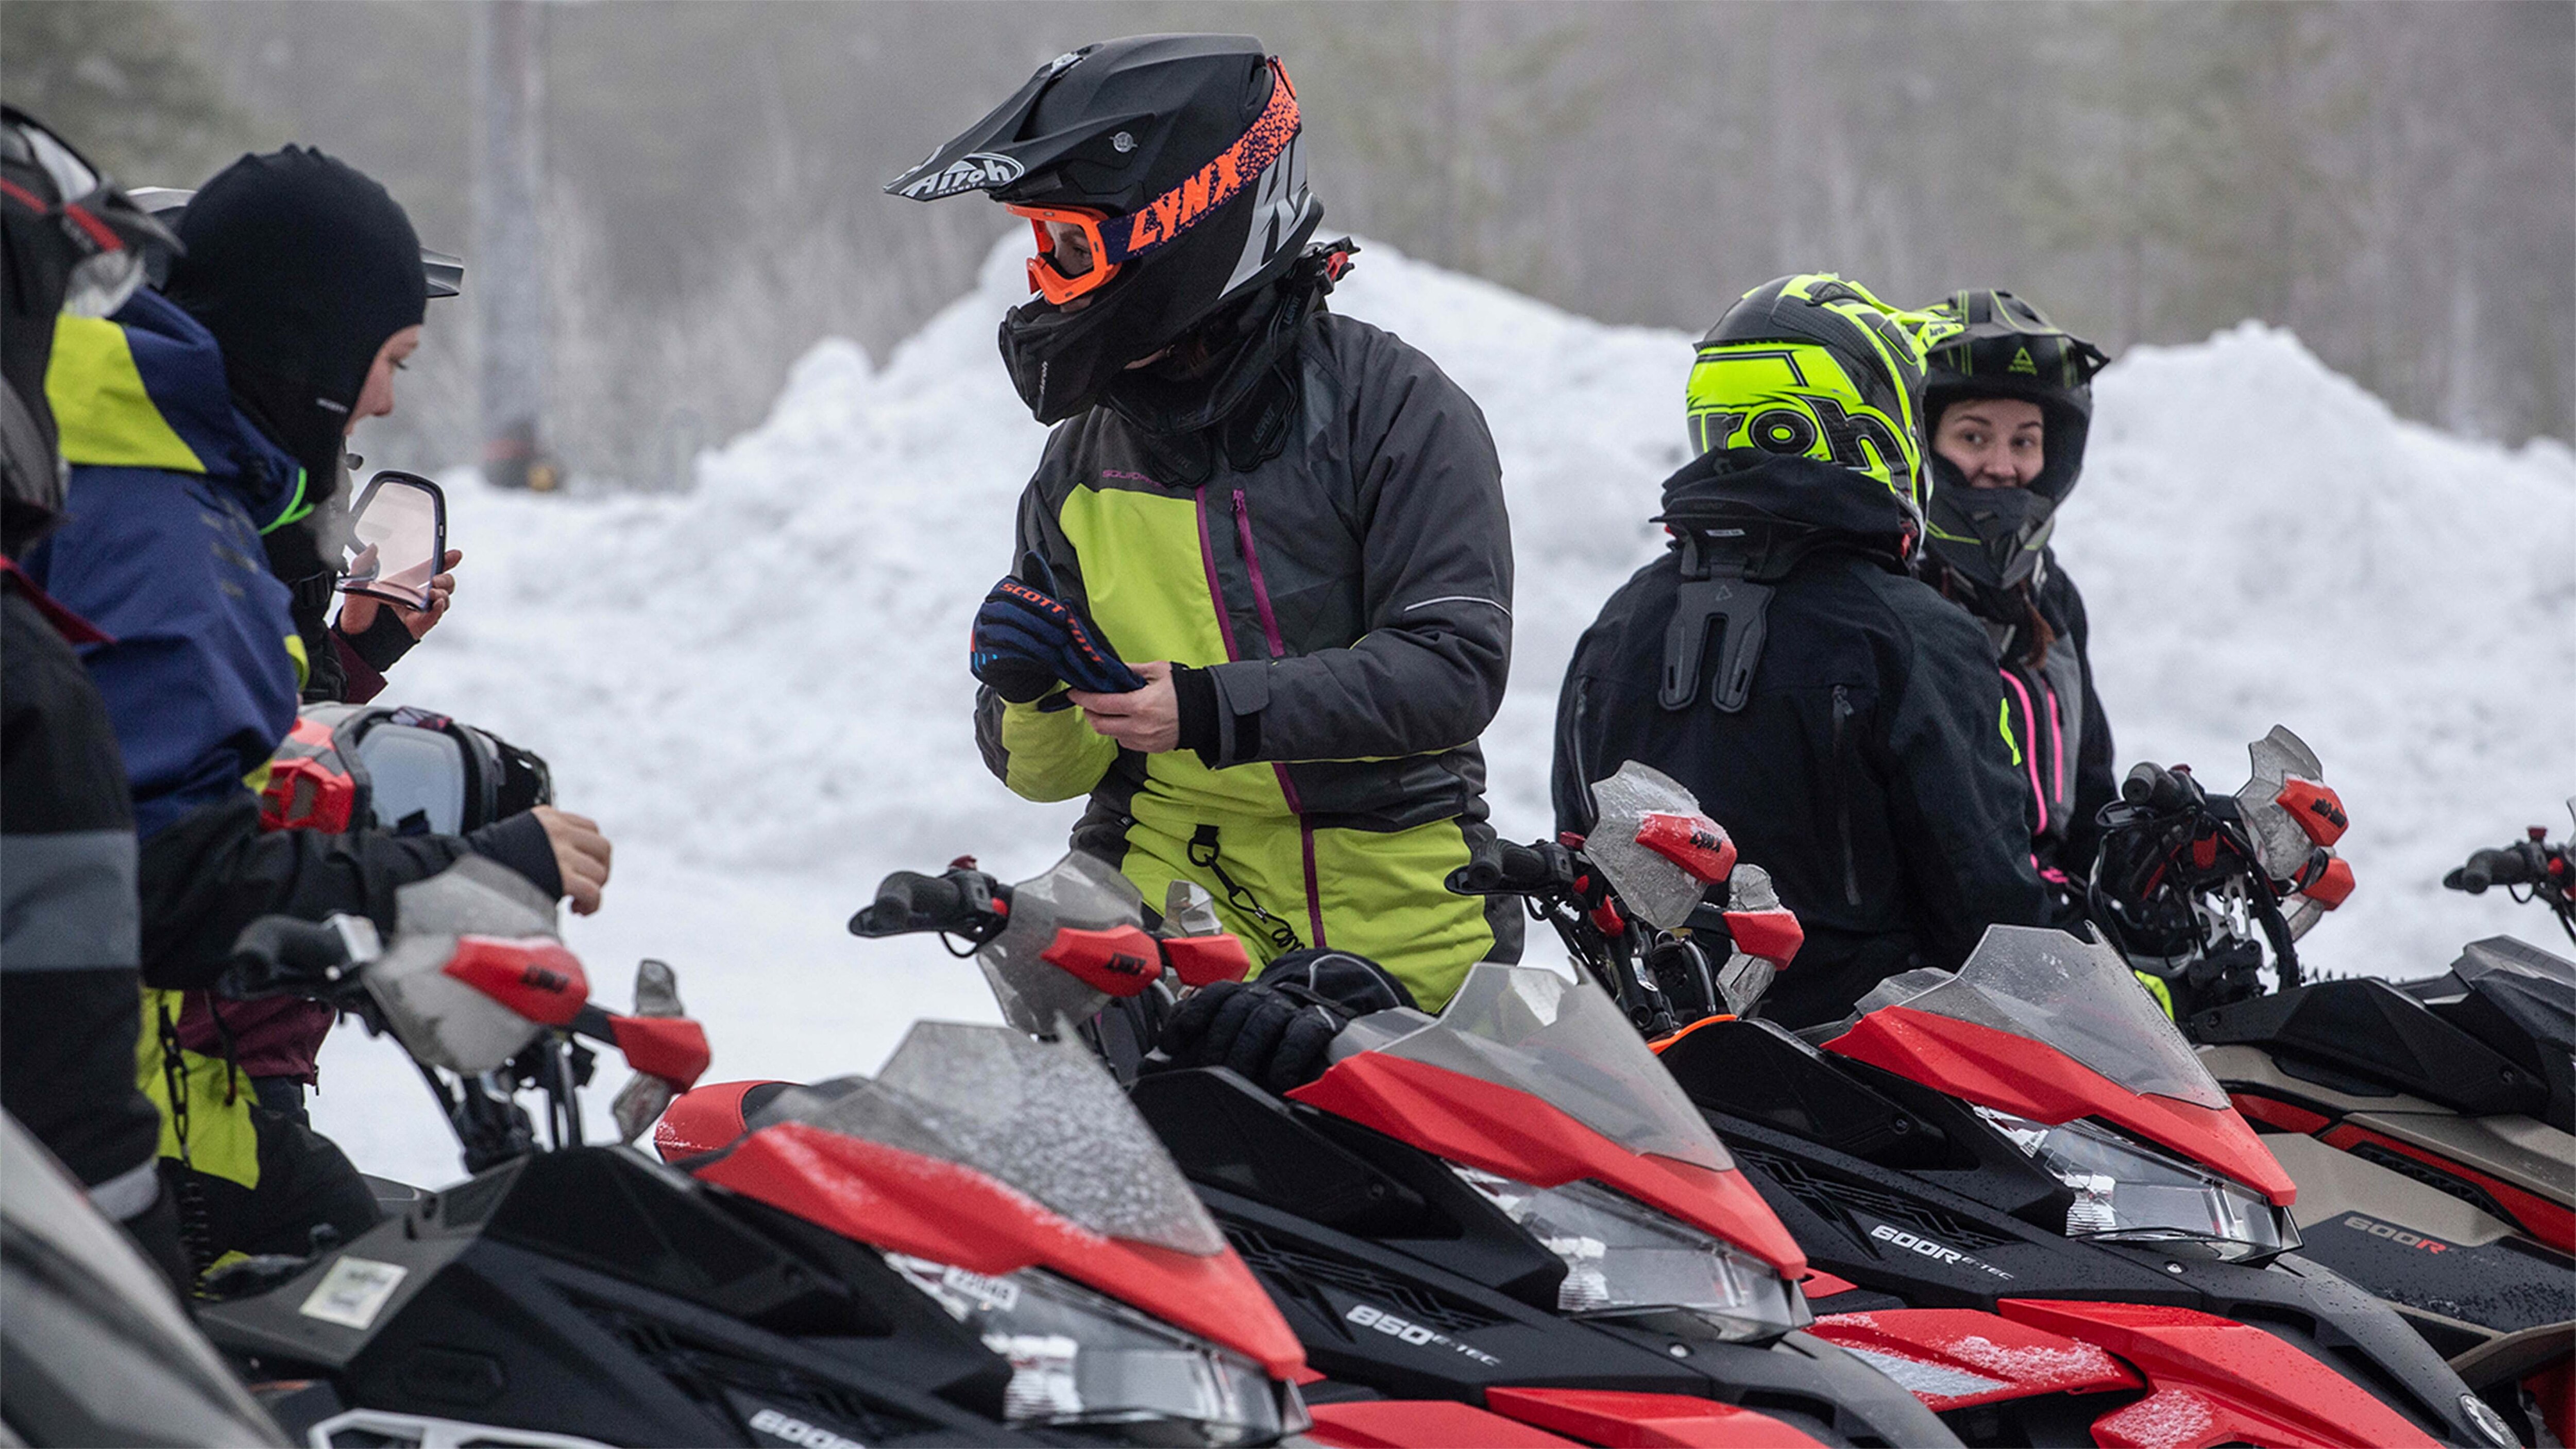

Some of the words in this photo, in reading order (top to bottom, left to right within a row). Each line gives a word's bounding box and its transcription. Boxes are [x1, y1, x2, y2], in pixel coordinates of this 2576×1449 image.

[900, 159, 1010, 197] Airoh
[1127, 138, 1244, 252] LYNX
[999, 583, 1065, 613] SCOTT
[1871, 1225, 1962, 1264] 600R
[2345, 1216, 2447, 1254] 600R
[1346, 1305, 1435, 1345] 850
